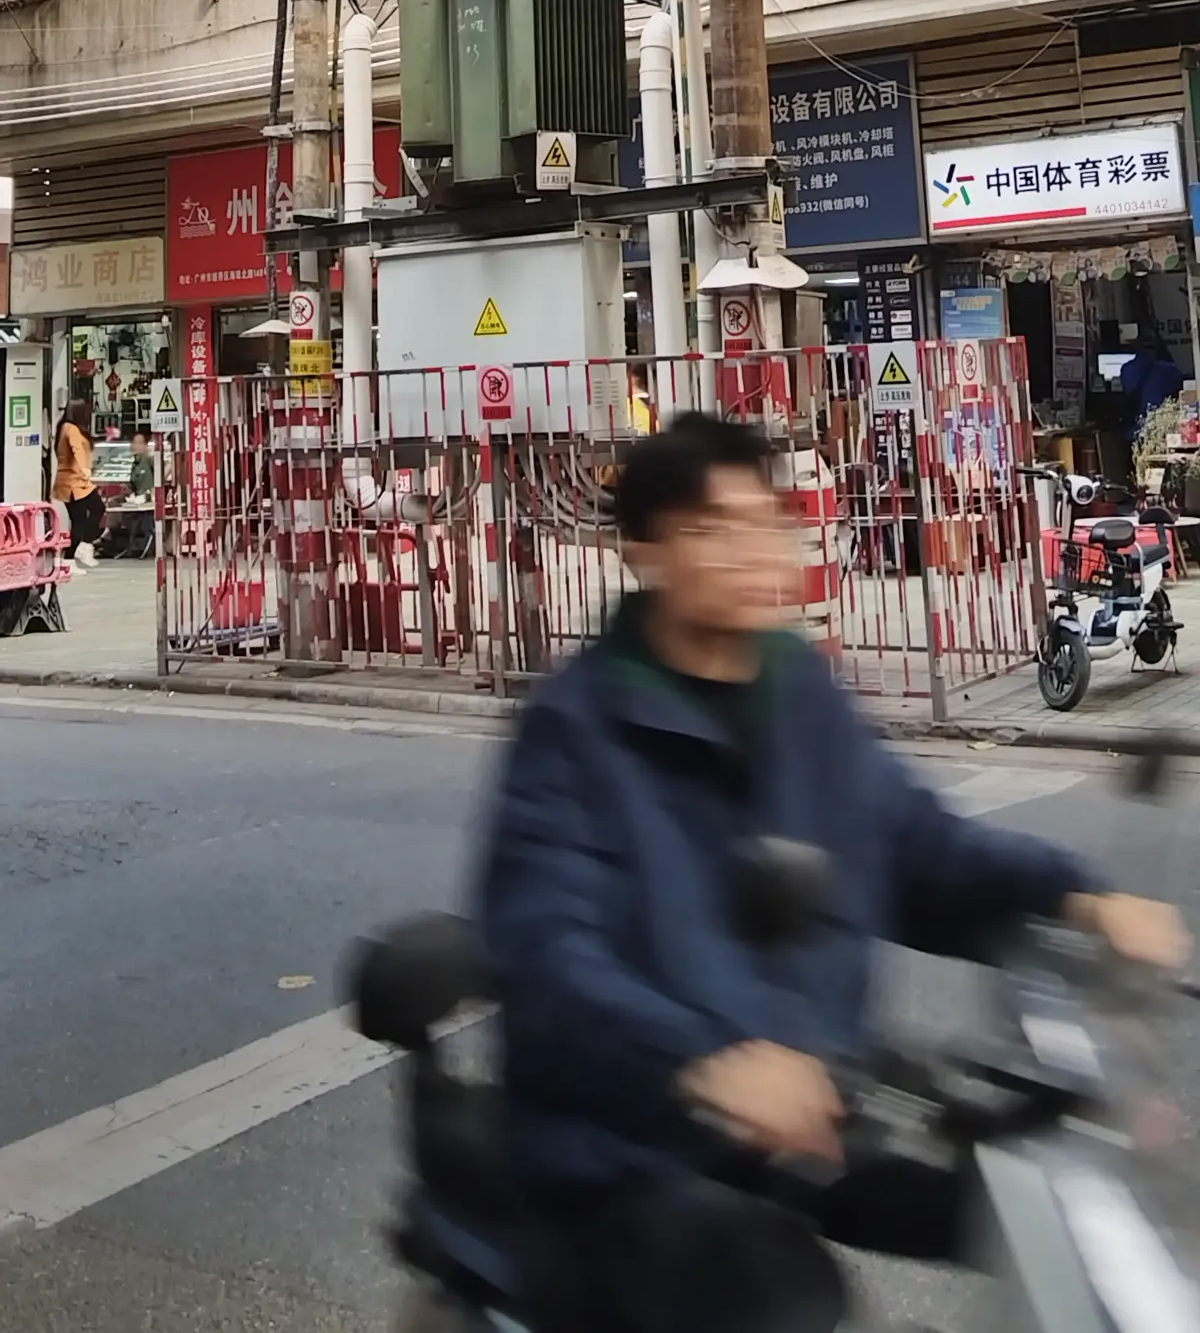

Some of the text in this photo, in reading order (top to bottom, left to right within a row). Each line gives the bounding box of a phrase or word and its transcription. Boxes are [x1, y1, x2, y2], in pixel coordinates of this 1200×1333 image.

[985, 150, 1171, 198] 中国体育彩票
[1093, 197, 1169, 216] 4401034142
[20, 244, 157, 293] 鸿业商店
